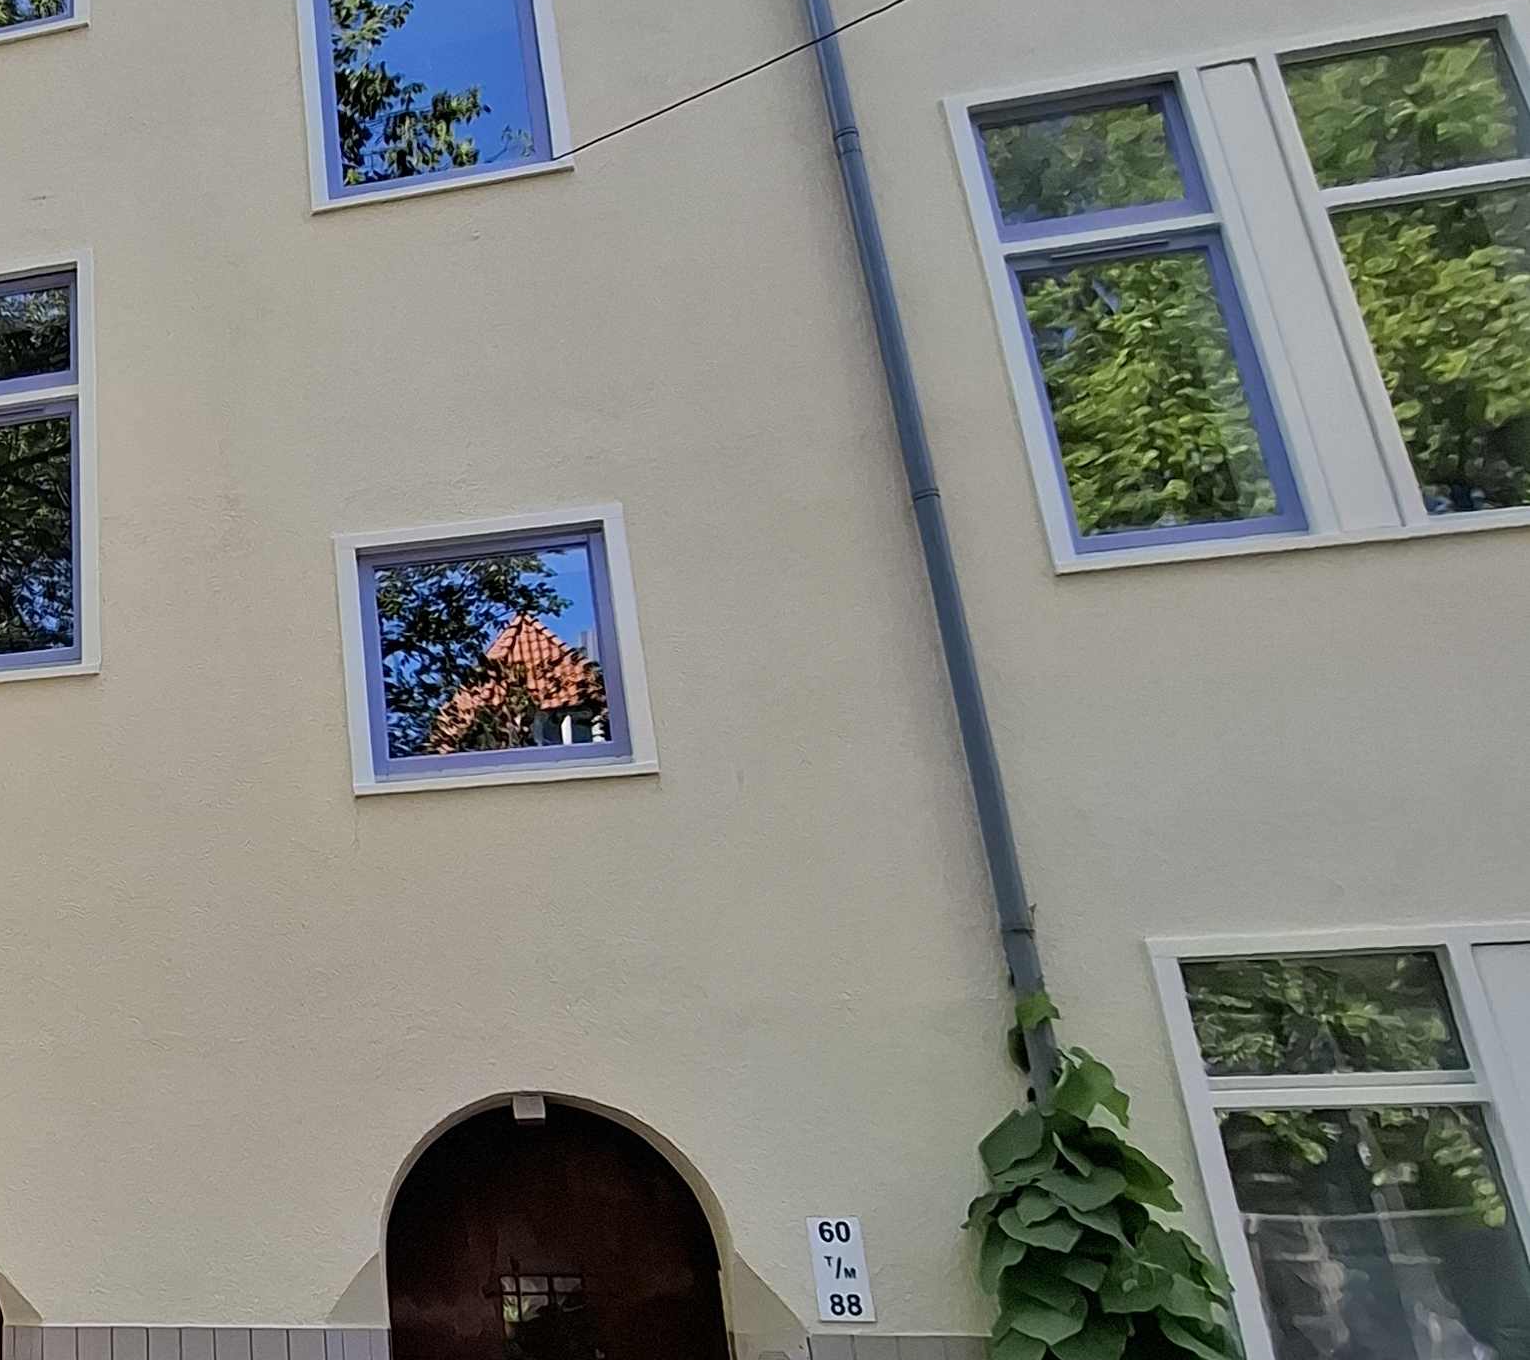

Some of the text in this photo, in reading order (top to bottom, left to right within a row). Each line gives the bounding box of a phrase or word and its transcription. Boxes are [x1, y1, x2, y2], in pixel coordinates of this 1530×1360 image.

[818, 1221, 851, 1243] 60
[823, 1255, 857, 1280] T/M
[830, 1293, 863, 1316] 88
